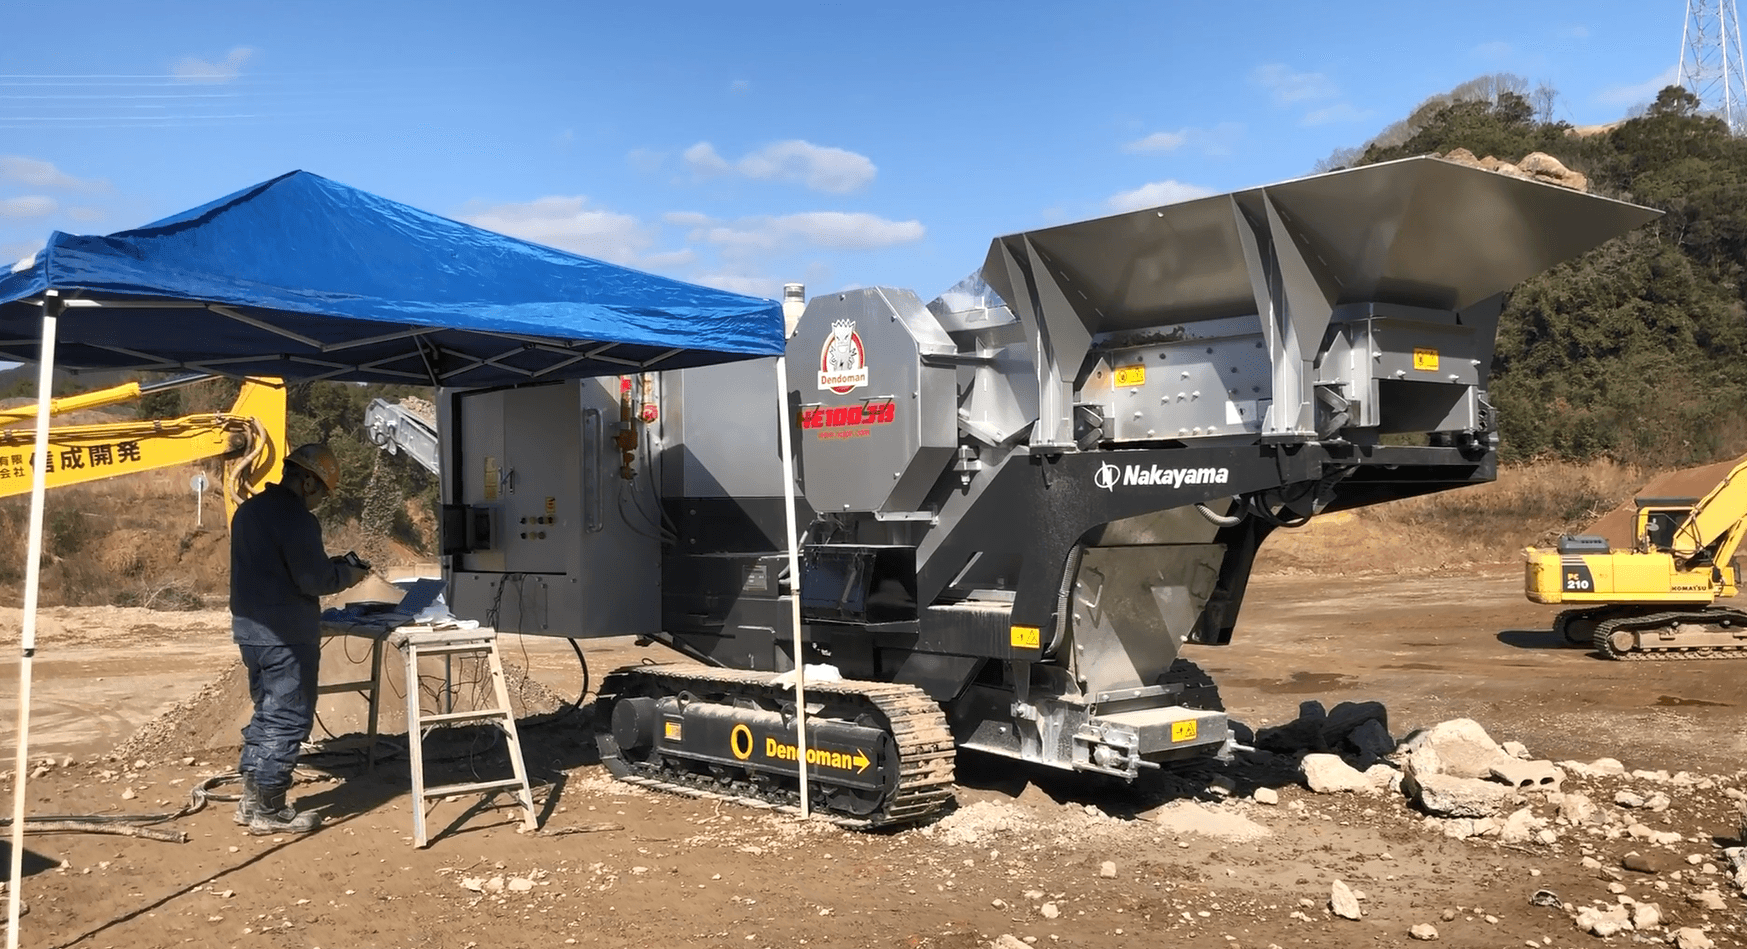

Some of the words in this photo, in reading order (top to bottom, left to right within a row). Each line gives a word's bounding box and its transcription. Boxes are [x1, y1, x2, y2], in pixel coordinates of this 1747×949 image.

[821, 373, 866, 385] Dendoman
[1123, 464, 1229, 489] Nakayama
[1567, 573, 1580, 581] PC
[1567, 580, 1590, 589] 210
